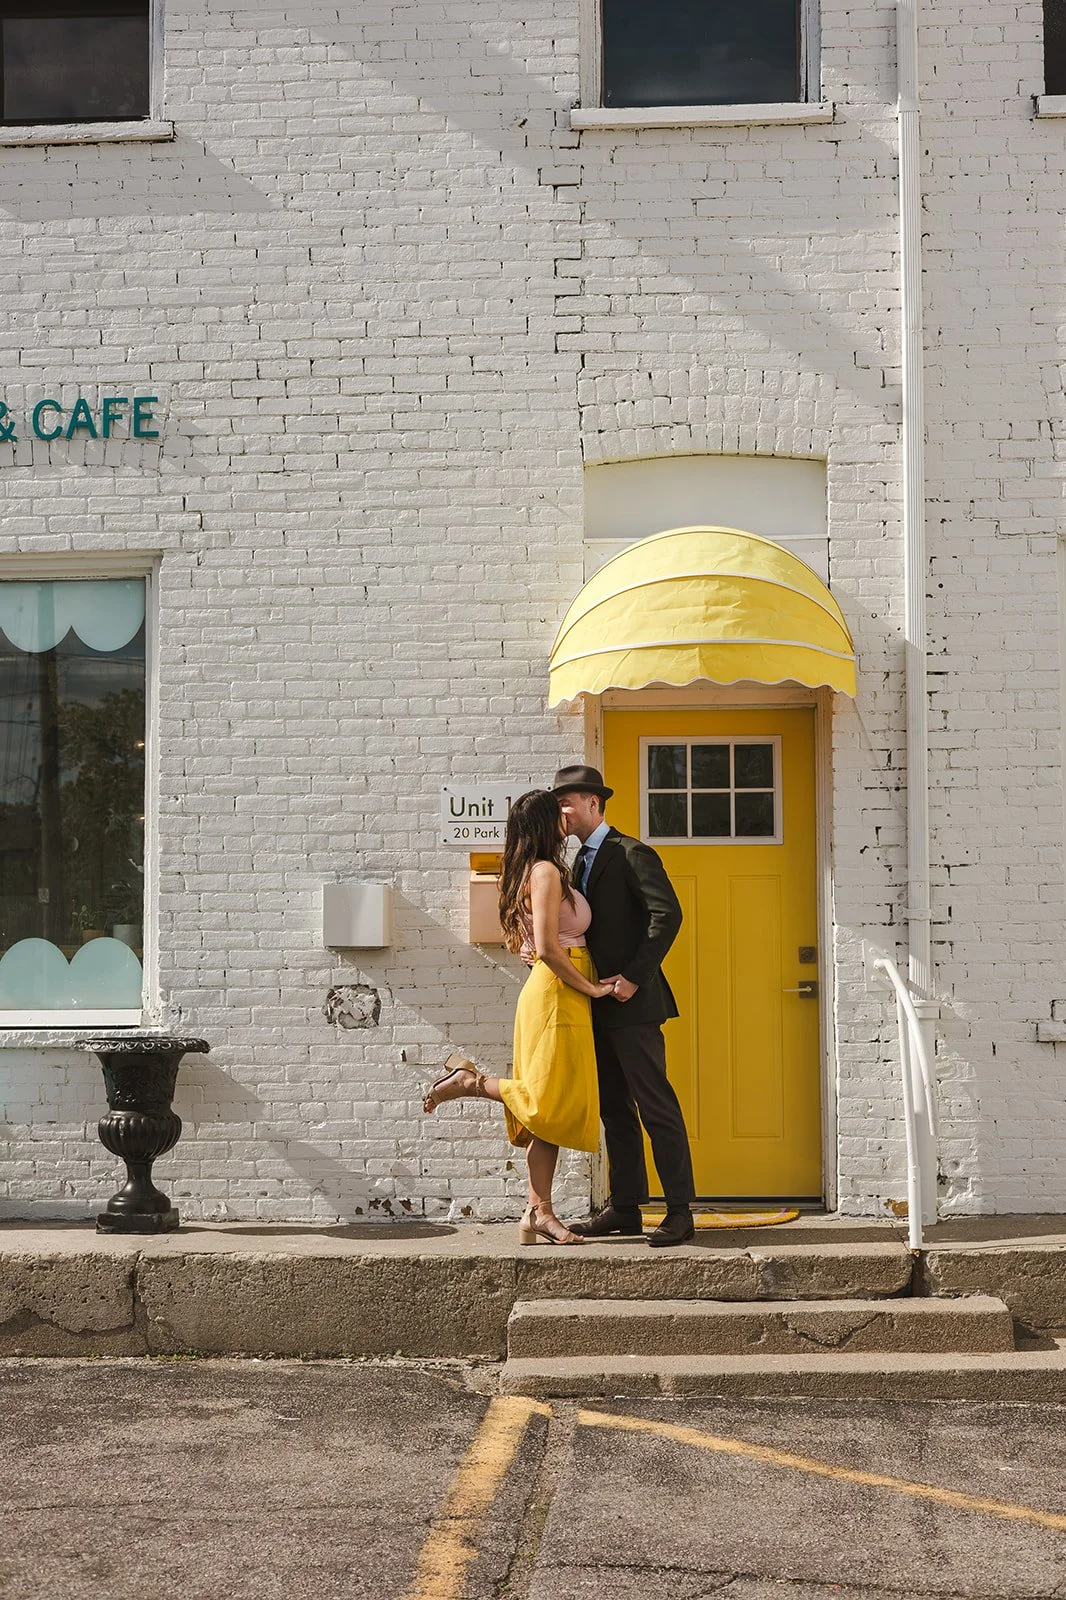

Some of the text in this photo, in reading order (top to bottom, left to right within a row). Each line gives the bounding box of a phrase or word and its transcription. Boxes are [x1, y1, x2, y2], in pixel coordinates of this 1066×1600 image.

[0, 396, 160, 442] & CAFE
[450, 796, 494, 817] Unit
[453, 827, 470, 839] 20
[474, 826, 500, 839] Park
